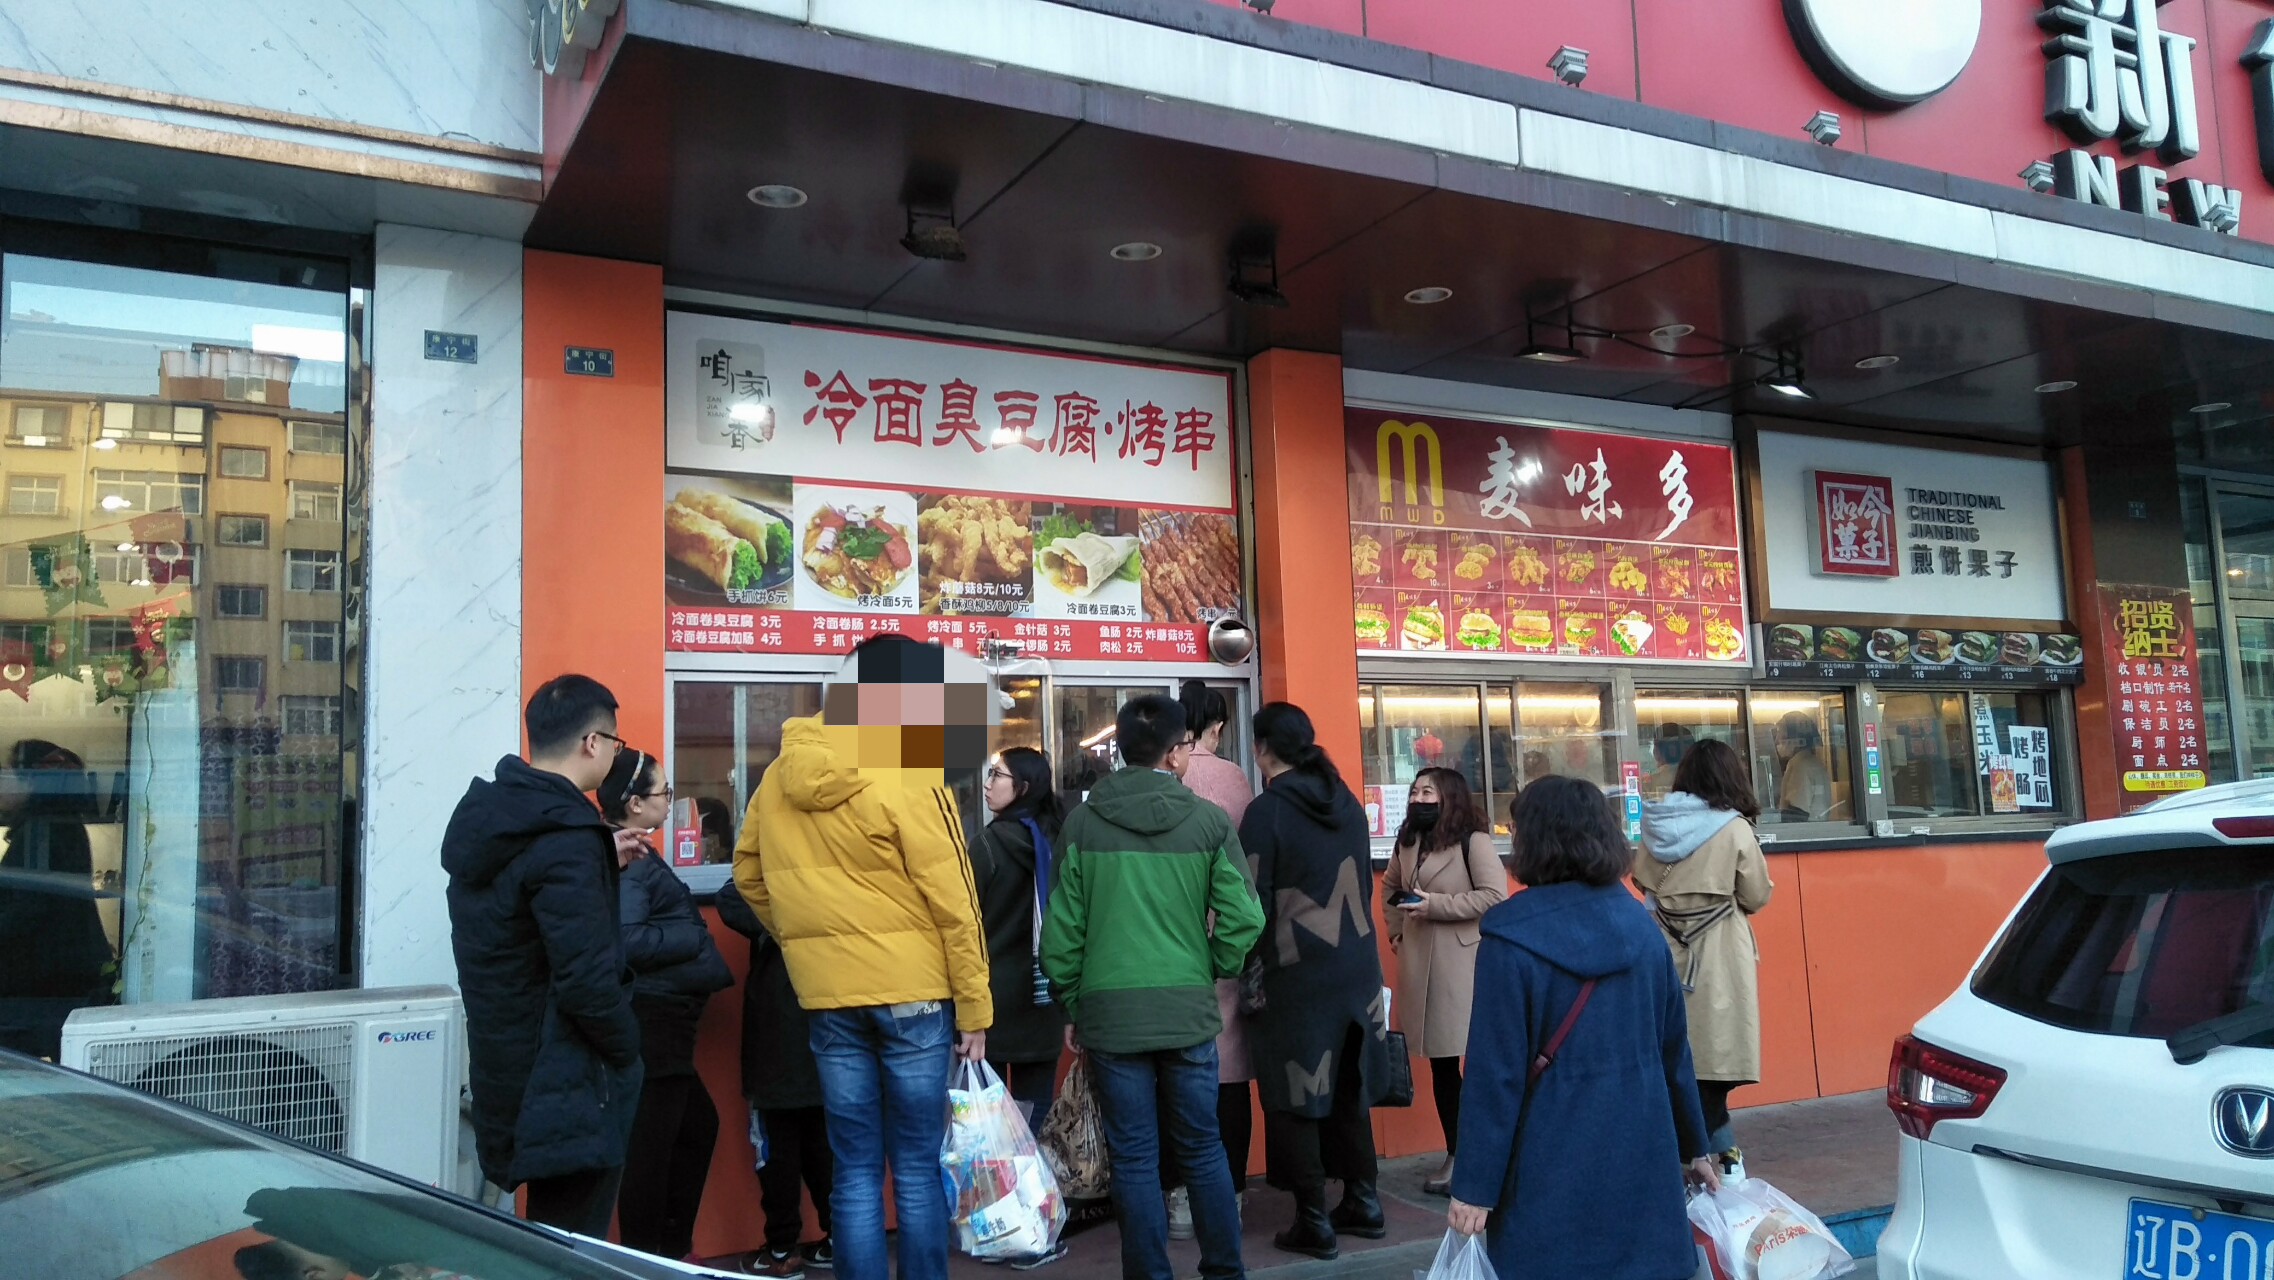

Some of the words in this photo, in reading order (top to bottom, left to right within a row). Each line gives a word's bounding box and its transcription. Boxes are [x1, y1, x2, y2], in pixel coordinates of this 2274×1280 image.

[2054, 148, 2242, 238] NEW
[443, 346, 458, 359] 12
[582, 360, 596, 373] 10
[1479, 436, 1694, 541] 麦味多
[1905, 488, 2006, 511] TRADITIONAL
[1908, 505, 1975, 525] CHINESE
[1908, 523, 1981, 544] JIANBING
[1909, 543, 2019, 579] 煎饼果子
[939, 582, 1024, 596] 炸蘑菇8元/10元
[727, 589, 788, 604] 手抓饼6元
[857, 594, 914, 609] 烤冷面5元
[940, 597, 1030, 613] 香酥鸡柳5/8/10元
[1066, 602, 1137, 616] 冷面卷豆腐3元
[672, 611, 754, 628] 冷面卷臭豆腐
[760, 615, 782, 629] 3元
[2120, 599, 2176, 630] 招贤
[813, 616, 864, 631] 冷面卷肠
[870, 617, 900, 632] 2.5元
[927, 620, 963, 634] 烤冷面
[968, 622, 987, 634] 5元
[1014, 623, 1048, 637] 金针菇
[1053, 624, 1071, 637] 3元
[671, 629, 754, 645] 冷面卷豆腐加肠
[760, 631, 782, 646] 4元
[1099, 625, 1121, 638] 鱼肠
[1126, 626, 1143, 639] 2元
[1145, 628, 1195, 642] 炸蘑菇8元
[1053, 640, 1072, 653] 2元
[1099, 641, 1121, 654] 肉松
[1126, 641, 1144, 654] 2元
[1175, 641, 1197, 655] 10元
[2123, 628, 2178, 656] 纳士
[1823, 668, 1834, 677] 12
[1870, 670, 1880, 678] 12
[1915, 670, 1925, 678] 16
[1962, 671, 1972, 679] 13
[2004, 672, 2014, 680] 13
[2118, 662, 2164, 677] 收银员
[2172, 664, 2189, 677] 2名
[2049, 674, 2059, 682] 18
[2121, 681, 2165, 695] 档口制作
[2122, 699, 2168, 713] 刷碗工
[2176, 700, 2193, 713] 2名
[2123, 718, 2170, 731] 保洁员
[2178, 717, 2195, 731] 2名
[2132, 736, 2166, 749] 厨师
[2180, 736, 2197, 749] 2名
[2013, 736, 2031, 795] 烤肠
[2031, 730, 2050, 803] 烤地瓜
[2133, 753, 2168, 767] 面点
[2181, 753, 2199, 767] 2名
[393, 1030, 437, 1043] GREE
